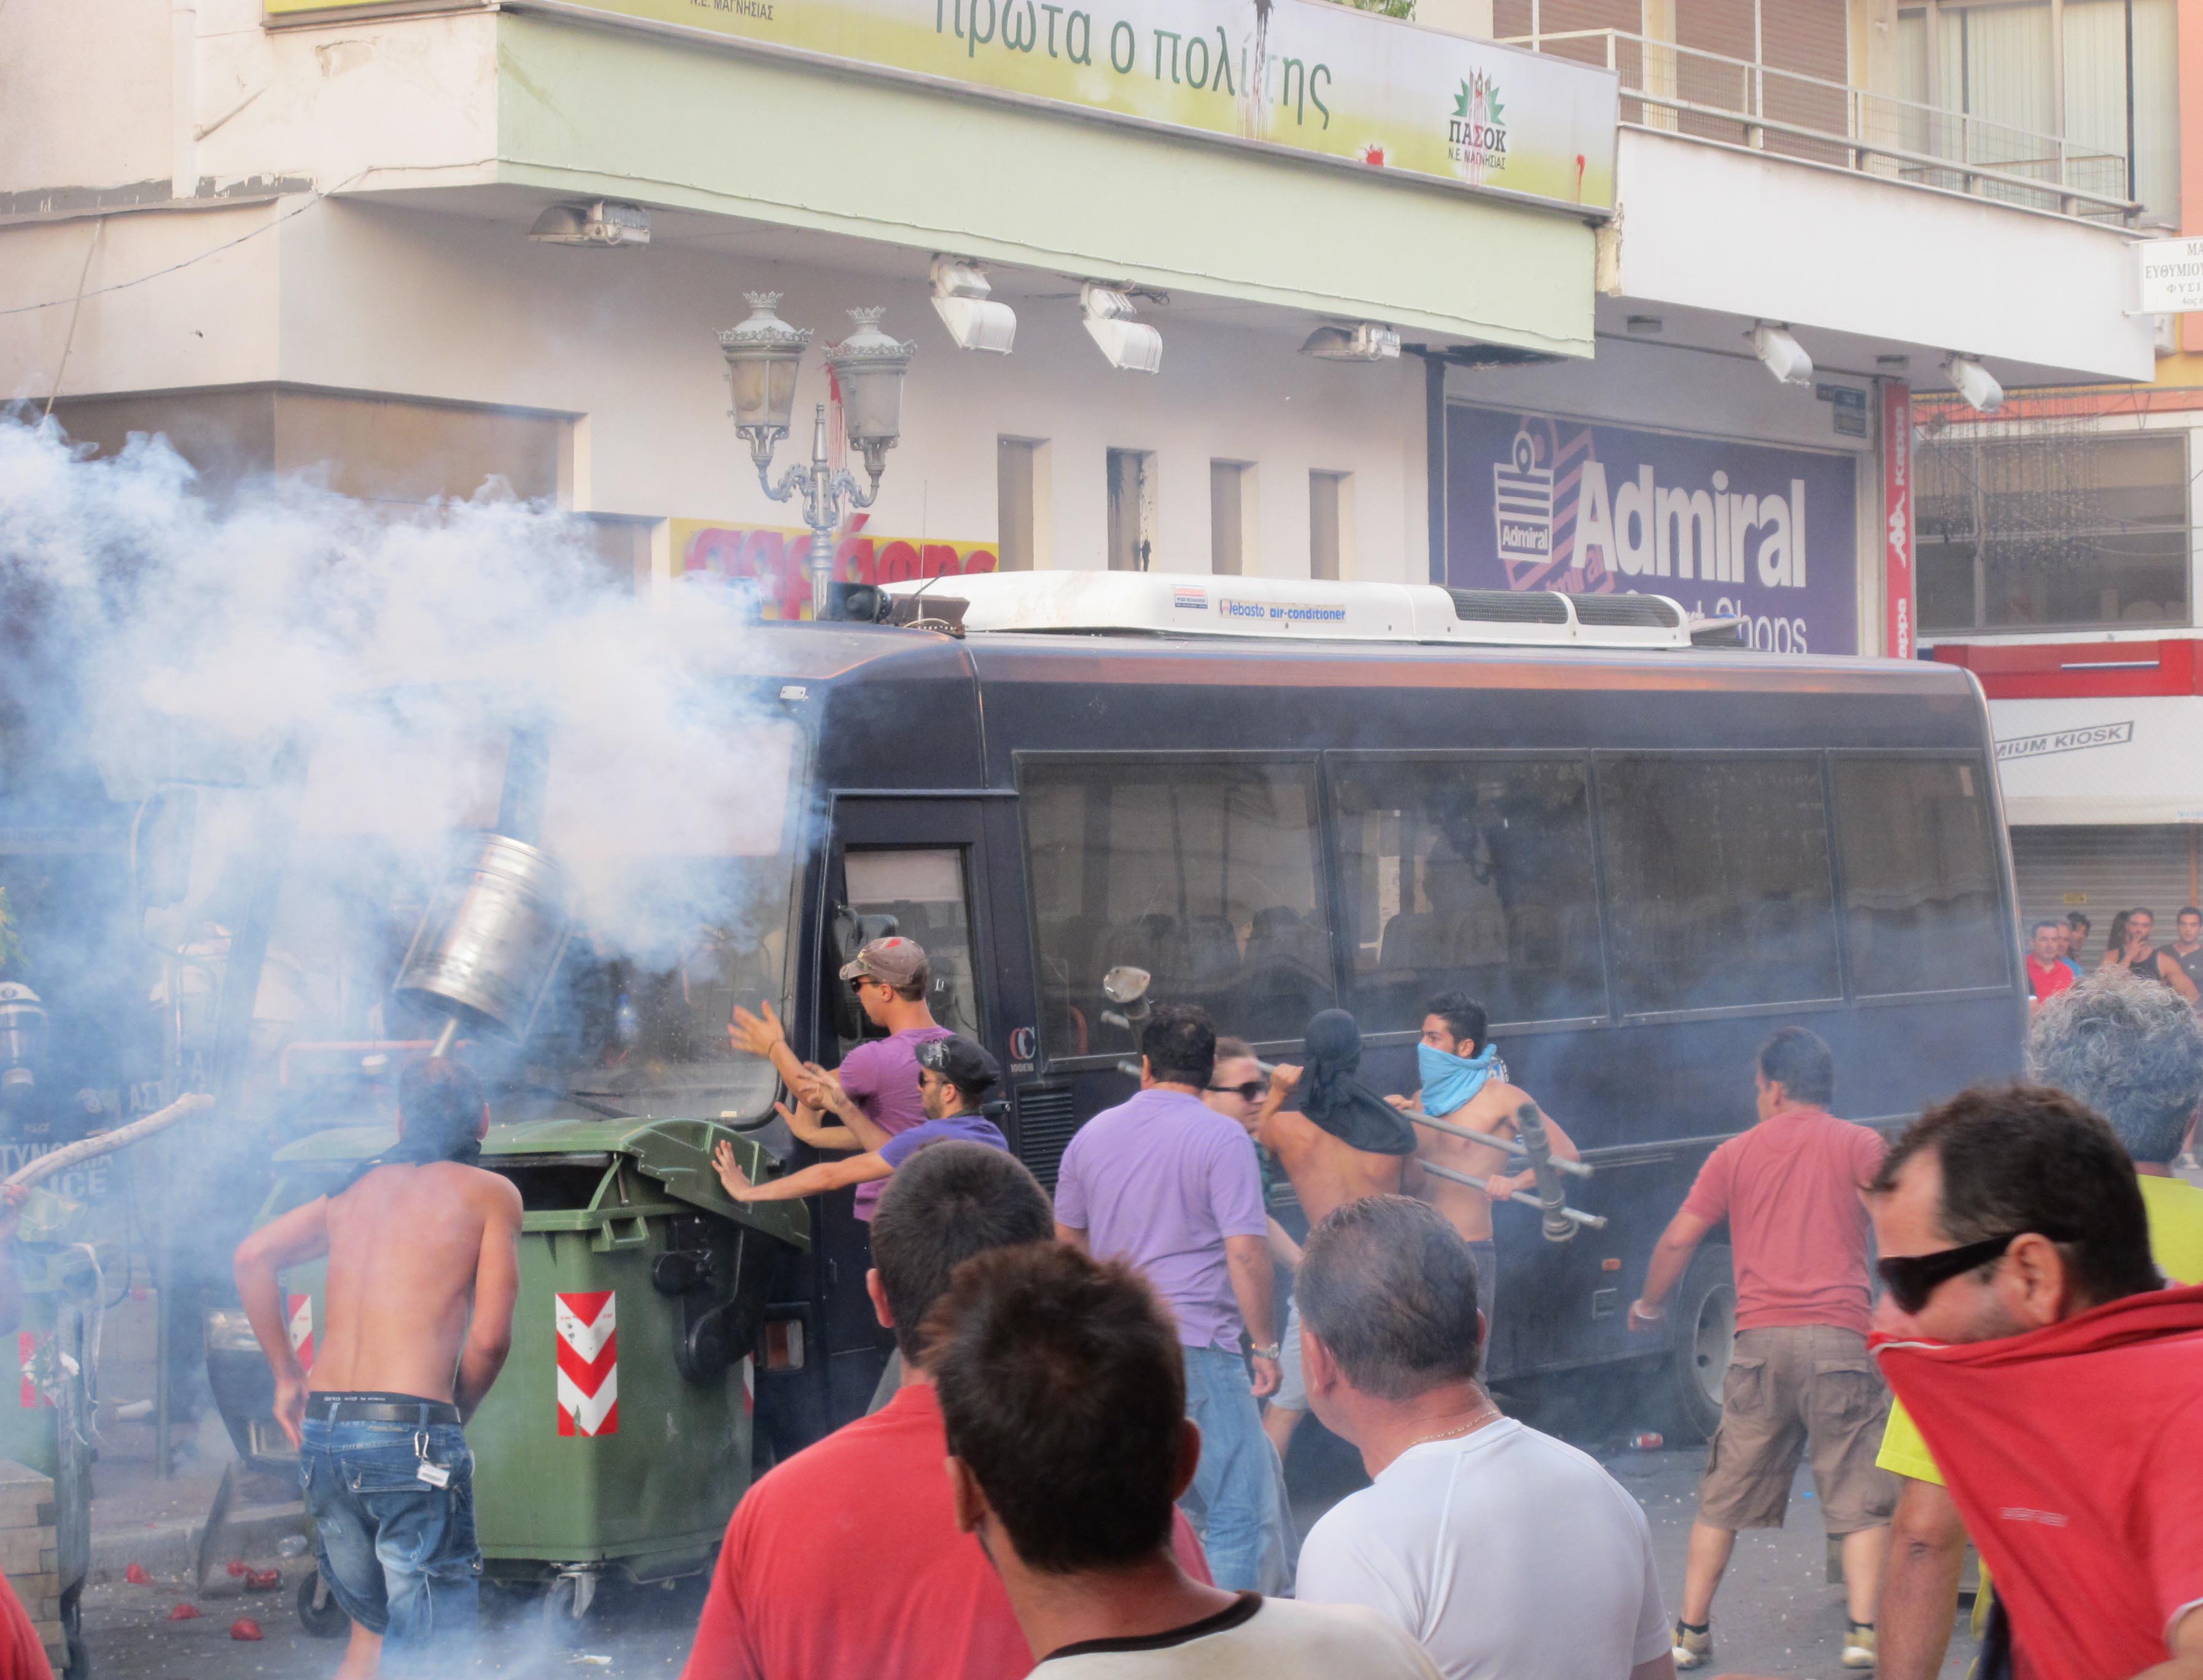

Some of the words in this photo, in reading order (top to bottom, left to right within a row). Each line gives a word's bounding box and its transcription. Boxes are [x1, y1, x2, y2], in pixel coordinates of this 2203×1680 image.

[1110, 20, 1135, 74] ο
[1449, 119, 1507, 153] ΠΑΣΟΚ
[1464, 149, 1506, 170] ΜΑΓΝΗΣΙΑΣ
[1895, 406, 1906, 485] Kappa
[1502, 525, 1548, 550] Admiral
[1571, 460, 1806, 588] Admiral
[1270, 607, 1345, 620] air-conditioner
[1898, 598, 1908, 659] appa
[2055, 727, 2121, 747] KIOSK
